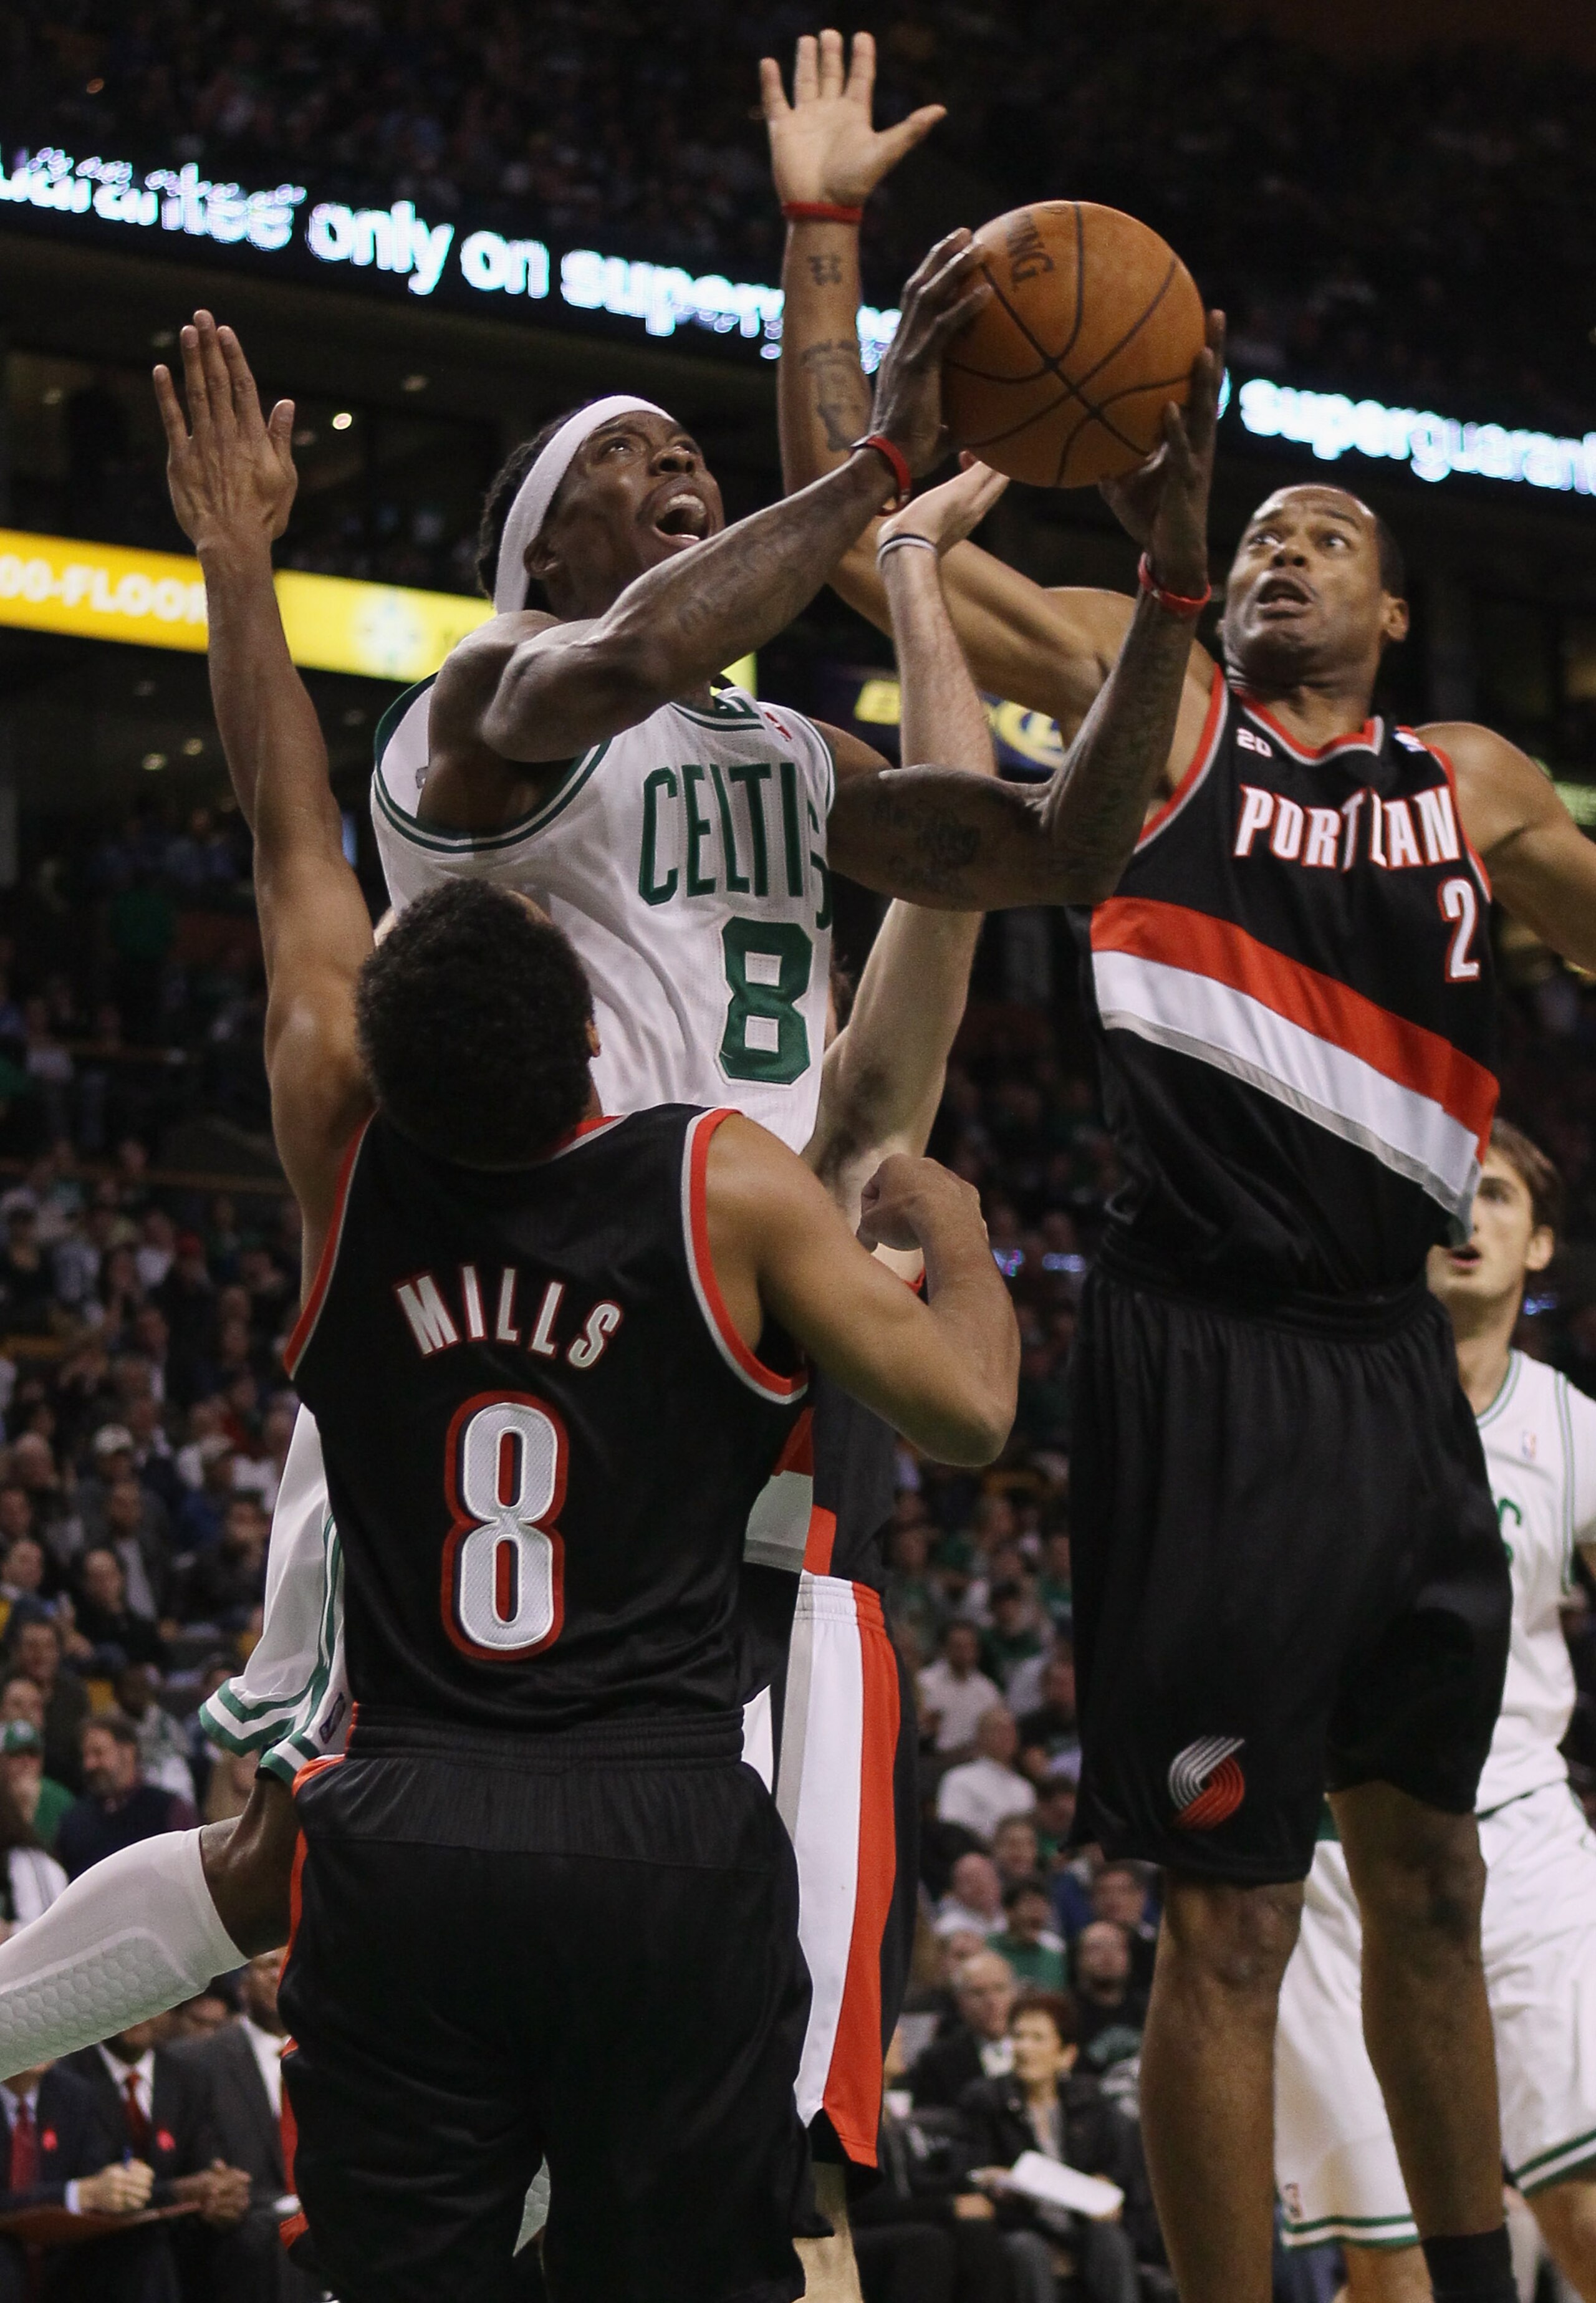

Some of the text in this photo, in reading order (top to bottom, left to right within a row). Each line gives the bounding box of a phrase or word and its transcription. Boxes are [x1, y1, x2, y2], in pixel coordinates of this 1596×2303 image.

[305, 200, 455, 296] only
[460, 231, 550, 299] on
[1438, 875, 1481, 983] 2
[718, 915, 814, 1085] 8
[393, 1262, 624, 1370] MILLS
[441, 1389, 570, 1661] 8
